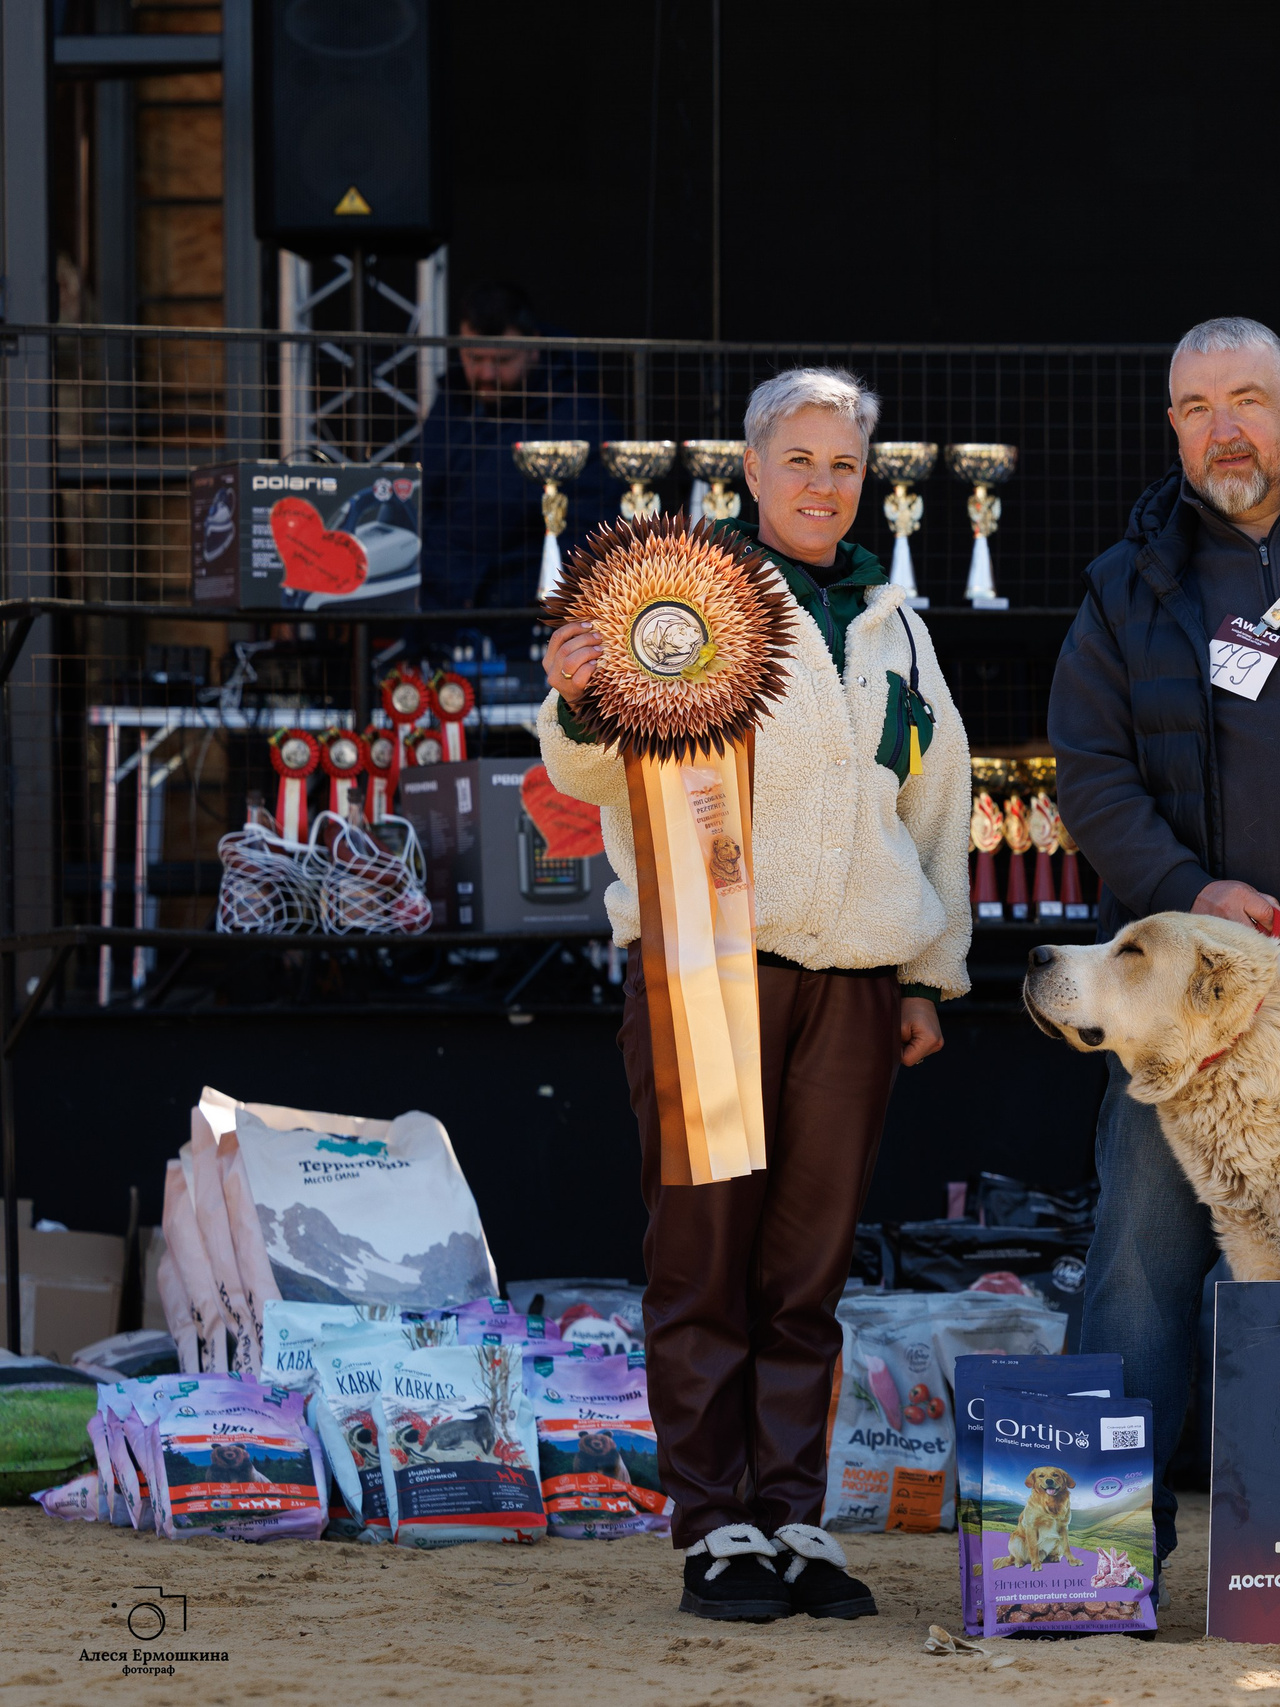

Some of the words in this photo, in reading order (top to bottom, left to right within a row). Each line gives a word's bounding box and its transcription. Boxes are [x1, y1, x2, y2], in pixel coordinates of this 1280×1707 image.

[252, 474, 338, 492] polaris
[1230, 616, 1280, 643] Awra
[1211, 643, 1262, 685] 79
[299, 1157, 412, 1174] Территория
[395, 1376, 457, 1401] КАВКАЗ
[995, 1437, 1019, 1446] holistic
[1034, 1441, 1050, 1449] food
[408, 1468, 441, 1478] Индейка
[415, 1472, 458, 1484] брусникой
[843, 1467, 889, 1484] MONO
[842, 1480, 888, 1495] PROTEIN
[501, 1501, 514, 1511] 2,5
[994, 1580, 1048, 1590] Ягненок
[1052, 1579, 1060, 1588] и
[1064, 1578, 1087, 1589] рис
[995, 1594, 1017, 1602] smart
[1018, 1591, 1068, 1601] temperature
[1068, 1591, 1097, 1599] control
